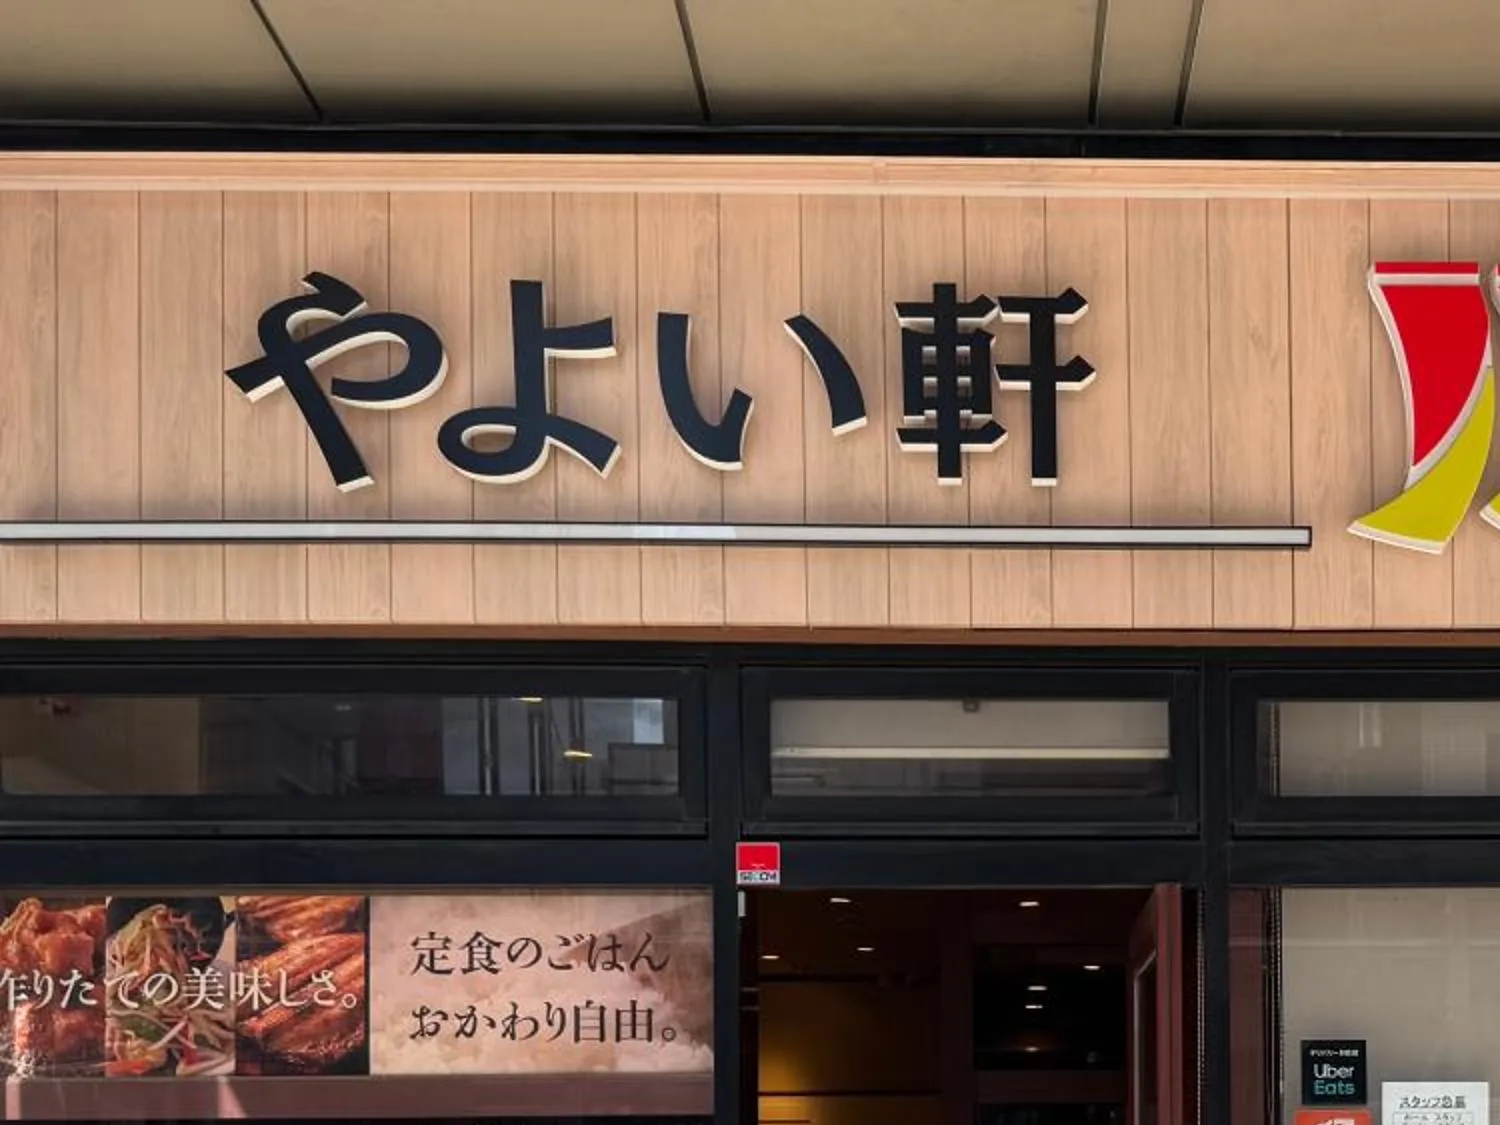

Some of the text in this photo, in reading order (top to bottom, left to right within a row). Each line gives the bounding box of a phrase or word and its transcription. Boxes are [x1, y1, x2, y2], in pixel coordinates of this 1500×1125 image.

[225, 271, 1097, 492] やよい軒
[409, 931, 671, 977] 定食のごはん
[0, 967, 358, 1010] 作りたての美味しさ。
[409, 1001, 678, 1044] おかわり自由。
[1313, 1063, 1354, 1078] Uber
[1314, 1081, 1355, 1095] Eats
